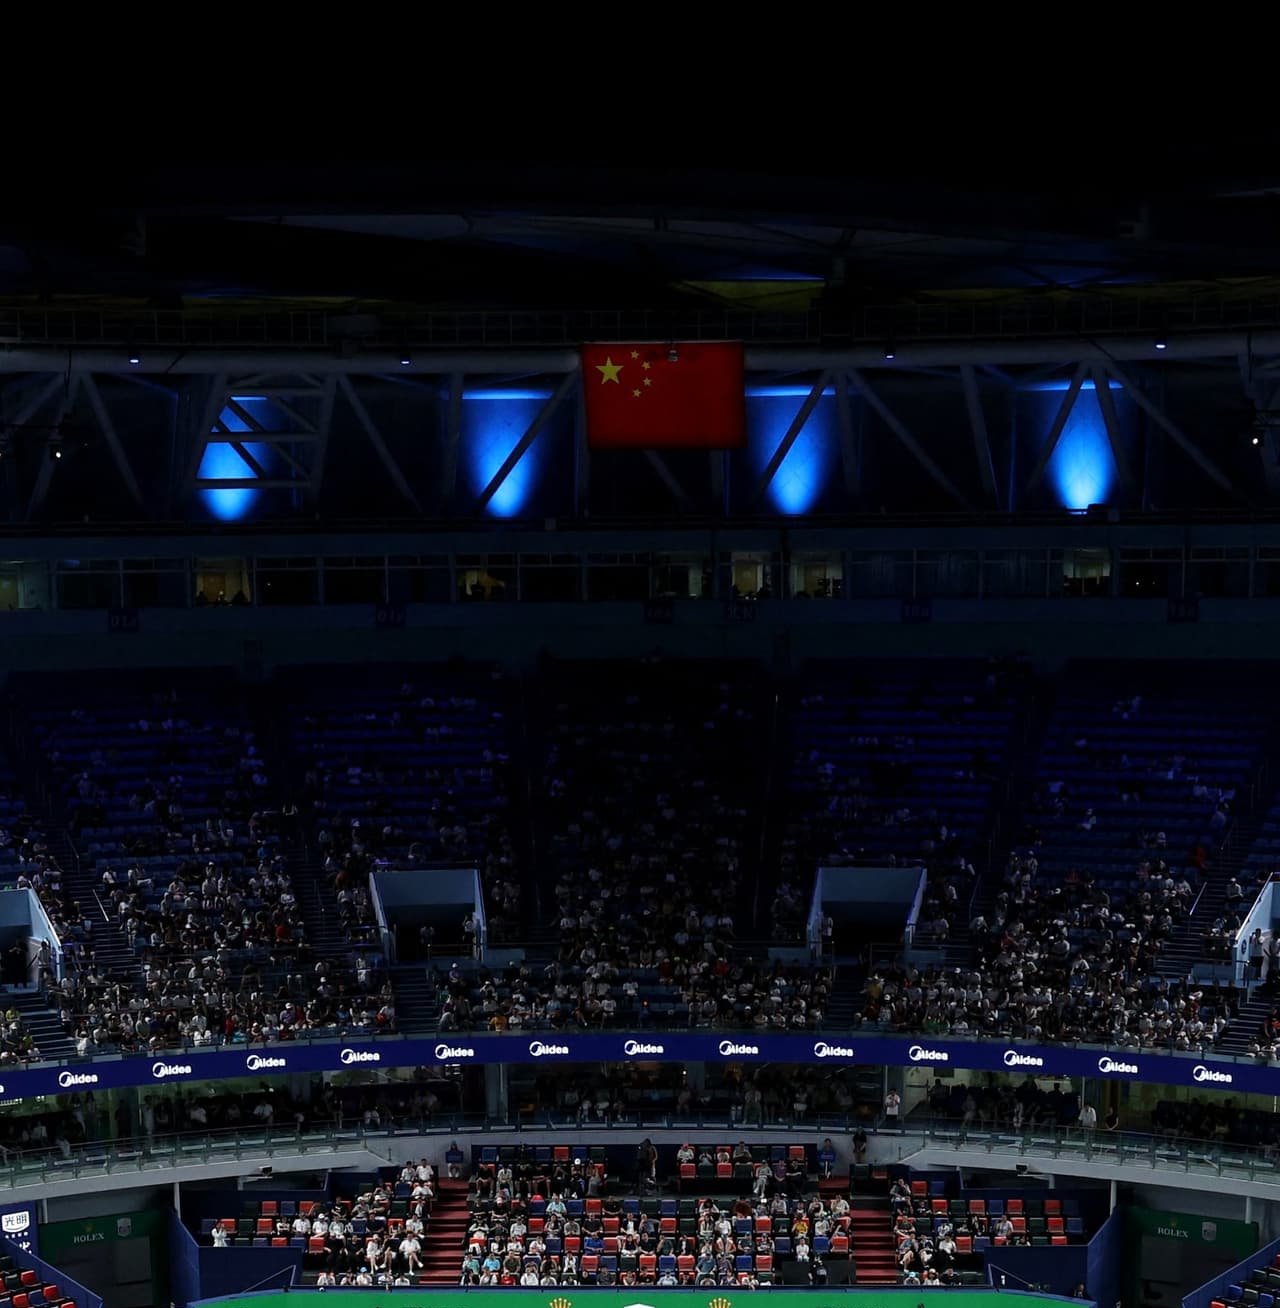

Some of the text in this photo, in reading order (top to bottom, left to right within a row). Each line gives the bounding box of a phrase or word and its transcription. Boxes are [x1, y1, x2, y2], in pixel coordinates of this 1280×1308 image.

[435, 1044, 474, 1059] Midea
[529, 1041, 568, 1056] Midea
[624, 1040, 664, 1055] Midea
[719, 1041, 758, 1055] Midea
[814, 1042, 853, 1057] Midea
[909, 1046, 948, 1061] Midea
[247, 1055, 285, 1070] Midea
[341, 1049, 380, 1064] Midea
[1004, 1050, 1043, 1066] Midea
[153, 1062, 191, 1077] Midea
[1099, 1057, 1138, 1073] Midea
[59, 1072, 98, 1087] Midea
[1193, 1065, 1232, 1082] Midea
[4, 1213, 28, 1227] 光明
[74, 1233, 104, 1243] ROLEX
[1158, 1227, 1189, 1238] ROLEX
